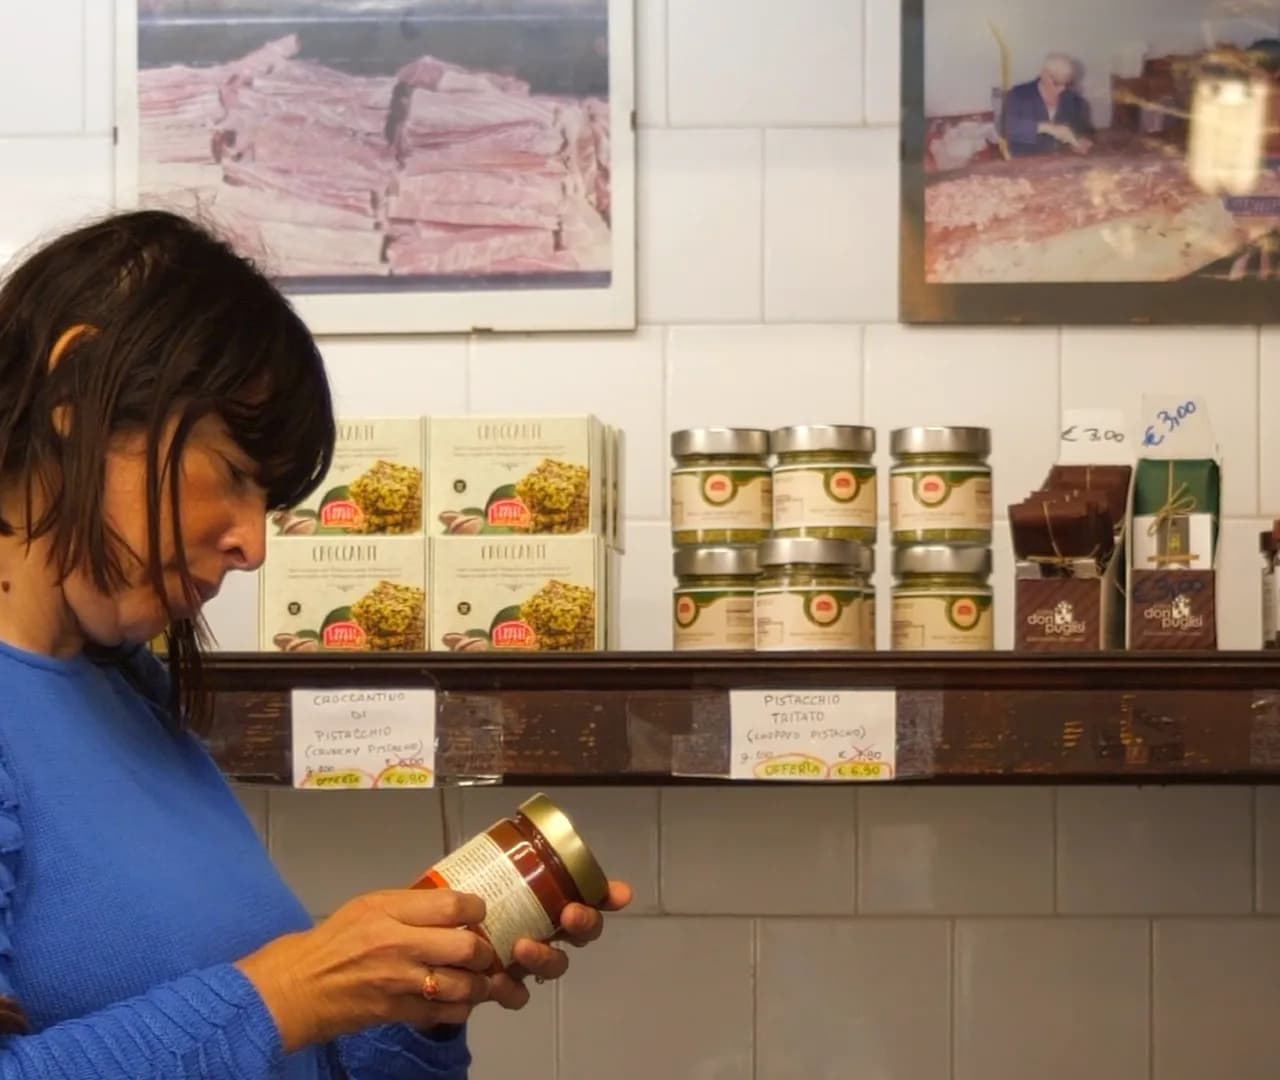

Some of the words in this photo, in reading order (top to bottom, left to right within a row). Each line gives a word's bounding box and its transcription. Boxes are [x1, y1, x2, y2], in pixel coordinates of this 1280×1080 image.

[1142, 425, 1165, 447] €
[1027, 612, 1054, 625] don
[1144, 606, 1172, 619] don
[764, 695, 840, 706] PISTACCHIO
[771, 711, 825, 724] TRITATO
[765, 762, 820, 776] OFFERTA
